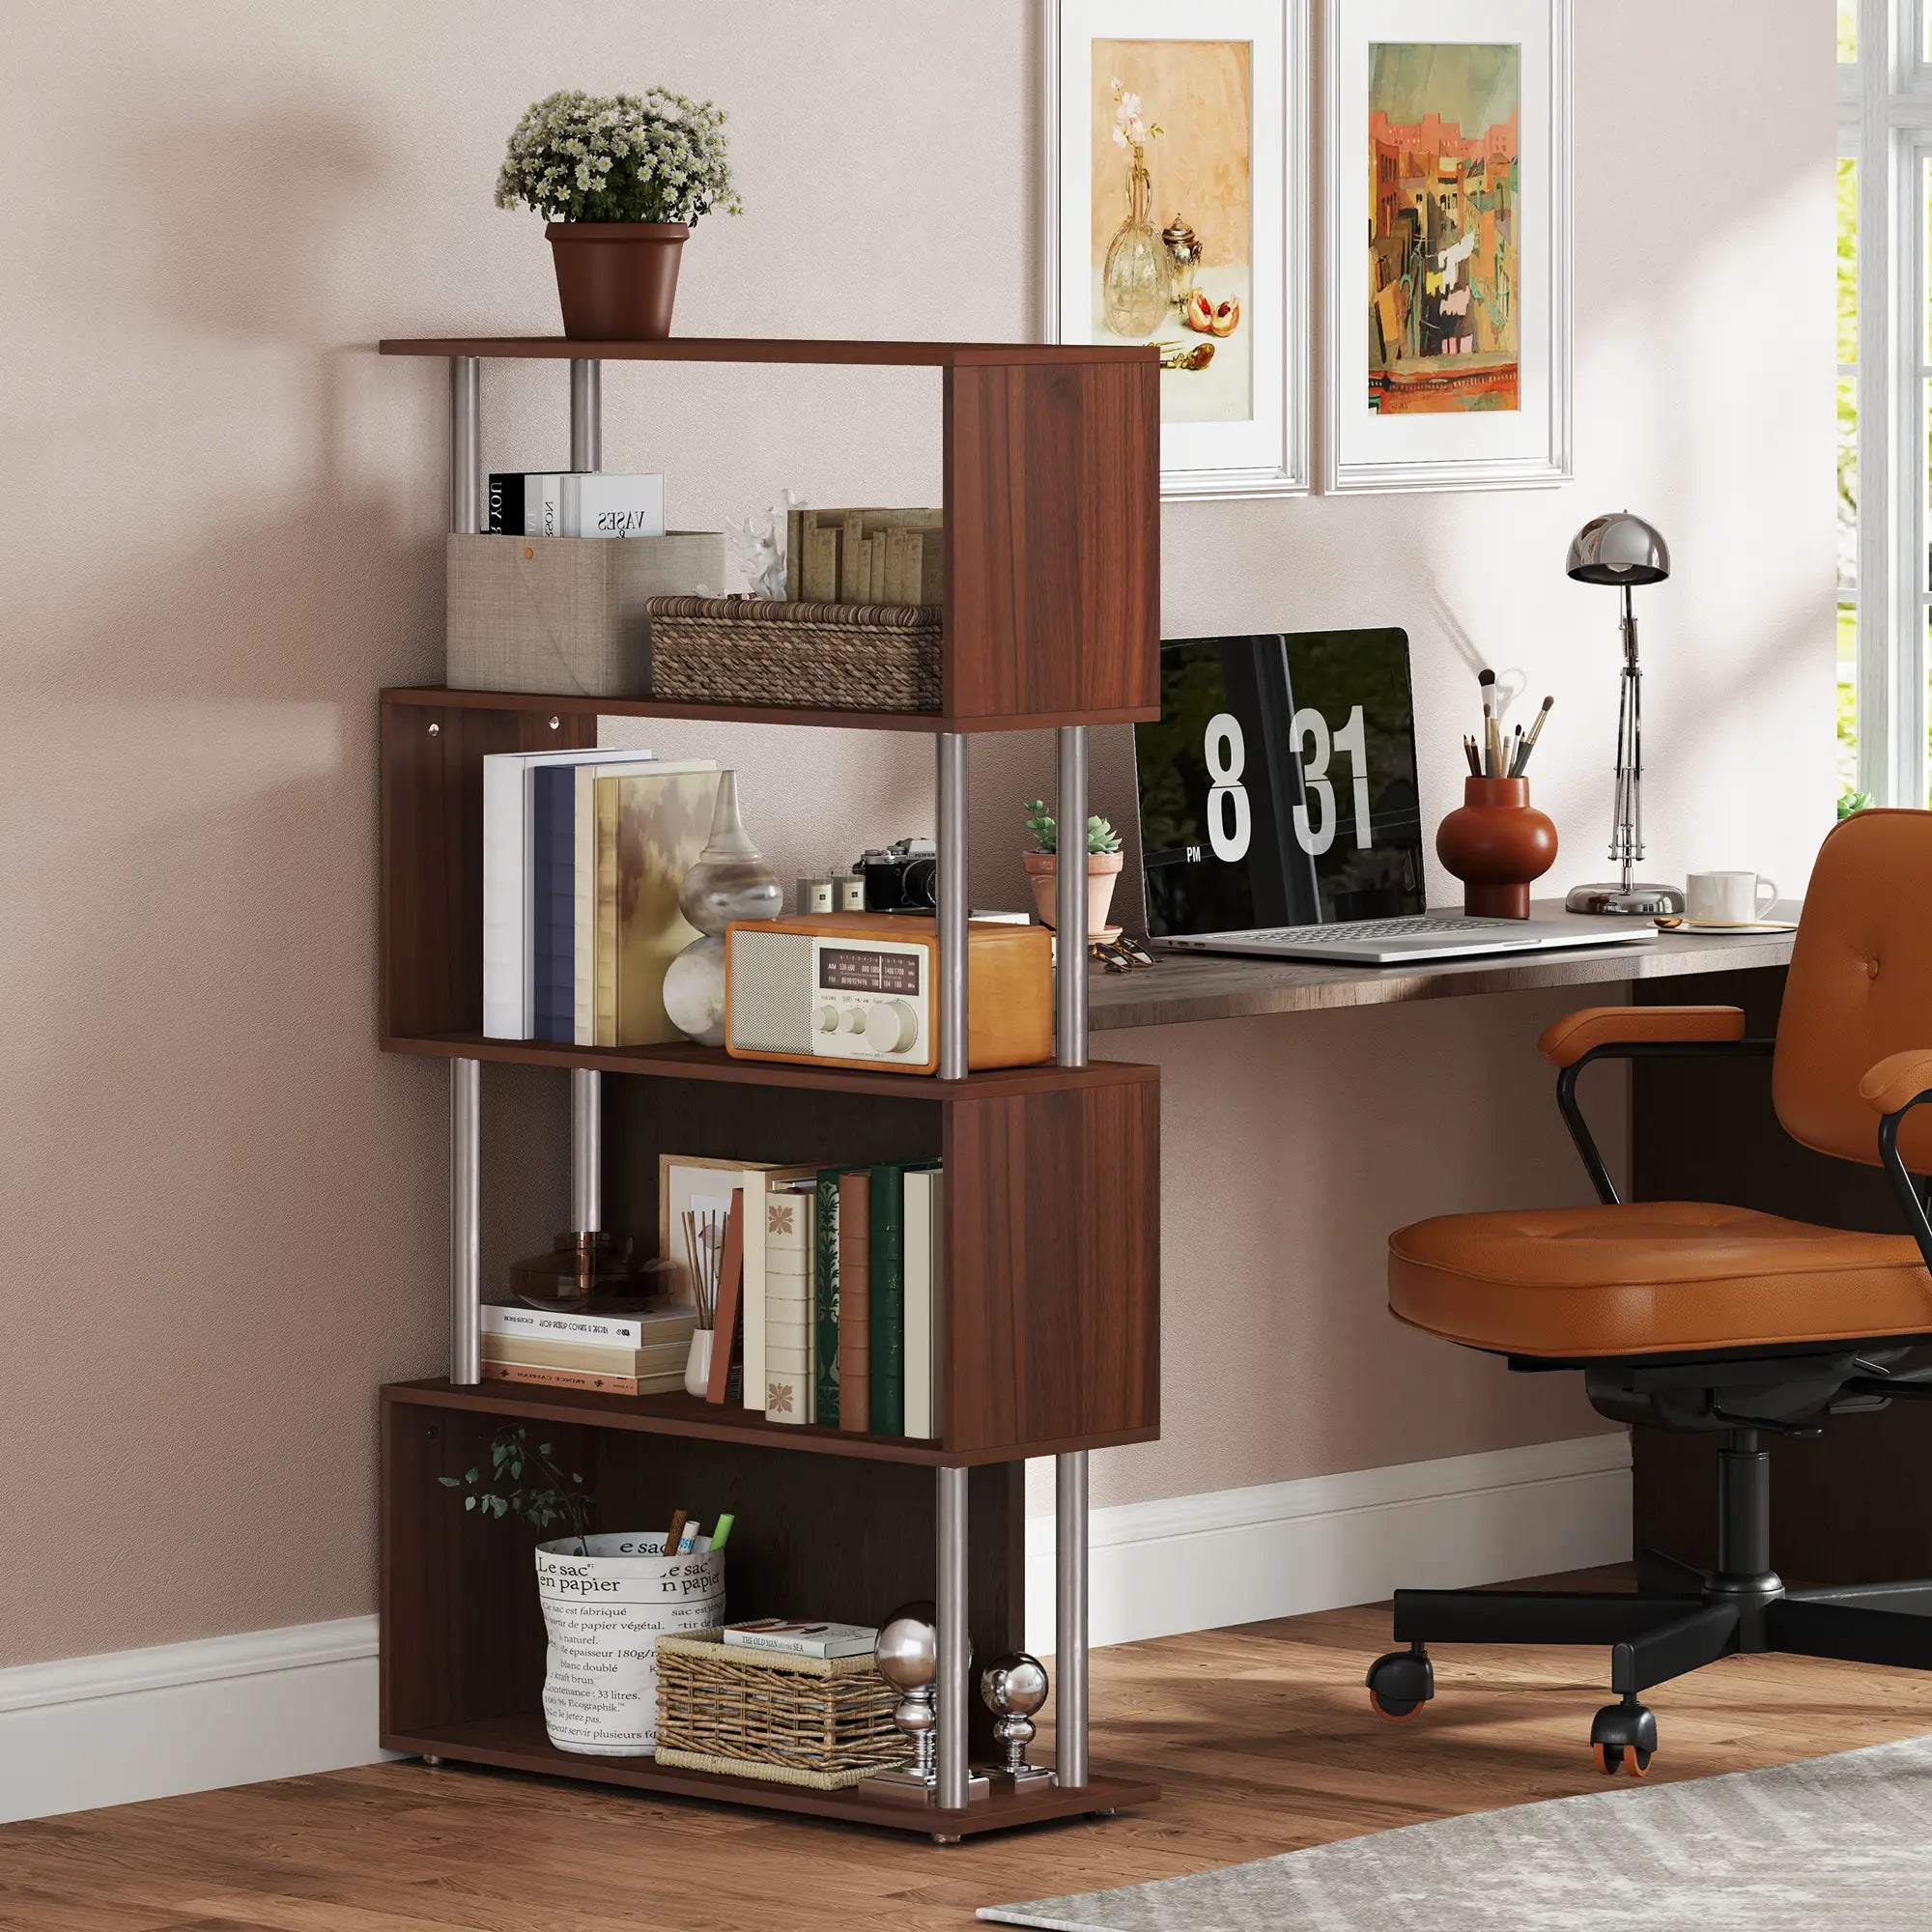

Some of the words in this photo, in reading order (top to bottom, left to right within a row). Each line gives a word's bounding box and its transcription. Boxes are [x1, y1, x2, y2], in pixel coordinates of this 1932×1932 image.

[1205, 713, 1251, 863] 8
[1290, 705, 1372, 856] 31
[1186, 846, 1201, 863] PM
[538, 1556, 556, 1574] Le
[540, 1576, 556, 1587] en
[559, 1577, 620, 1595] papier
[553, 1605, 563, 1613] sac
[565, 1606, 578, 1615] est
[580, 1606, 627, 1618] fabriqué
[568, 1620, 579, 1629] de
[581, 1621, 617, 1632] papier
[620, 1621, 665, 1632] végétal.
[563, 1635, 598, 1644] naturel.
[741, 1635, 753, 1645] THE
[569, 1647, 614, 1659] épaisseur
[560, 1660, 581, 1670] blanc
[582, 1662, 618, 1673] doublé
[572, 1674, 594, 1685] brun
[598, 1690, 609, 1699] 33
[611, 1690, 640, 1700] litres.
[568, 1726, 591, 1737] servir
[593, 1729, 641, 1740] plusieurs
